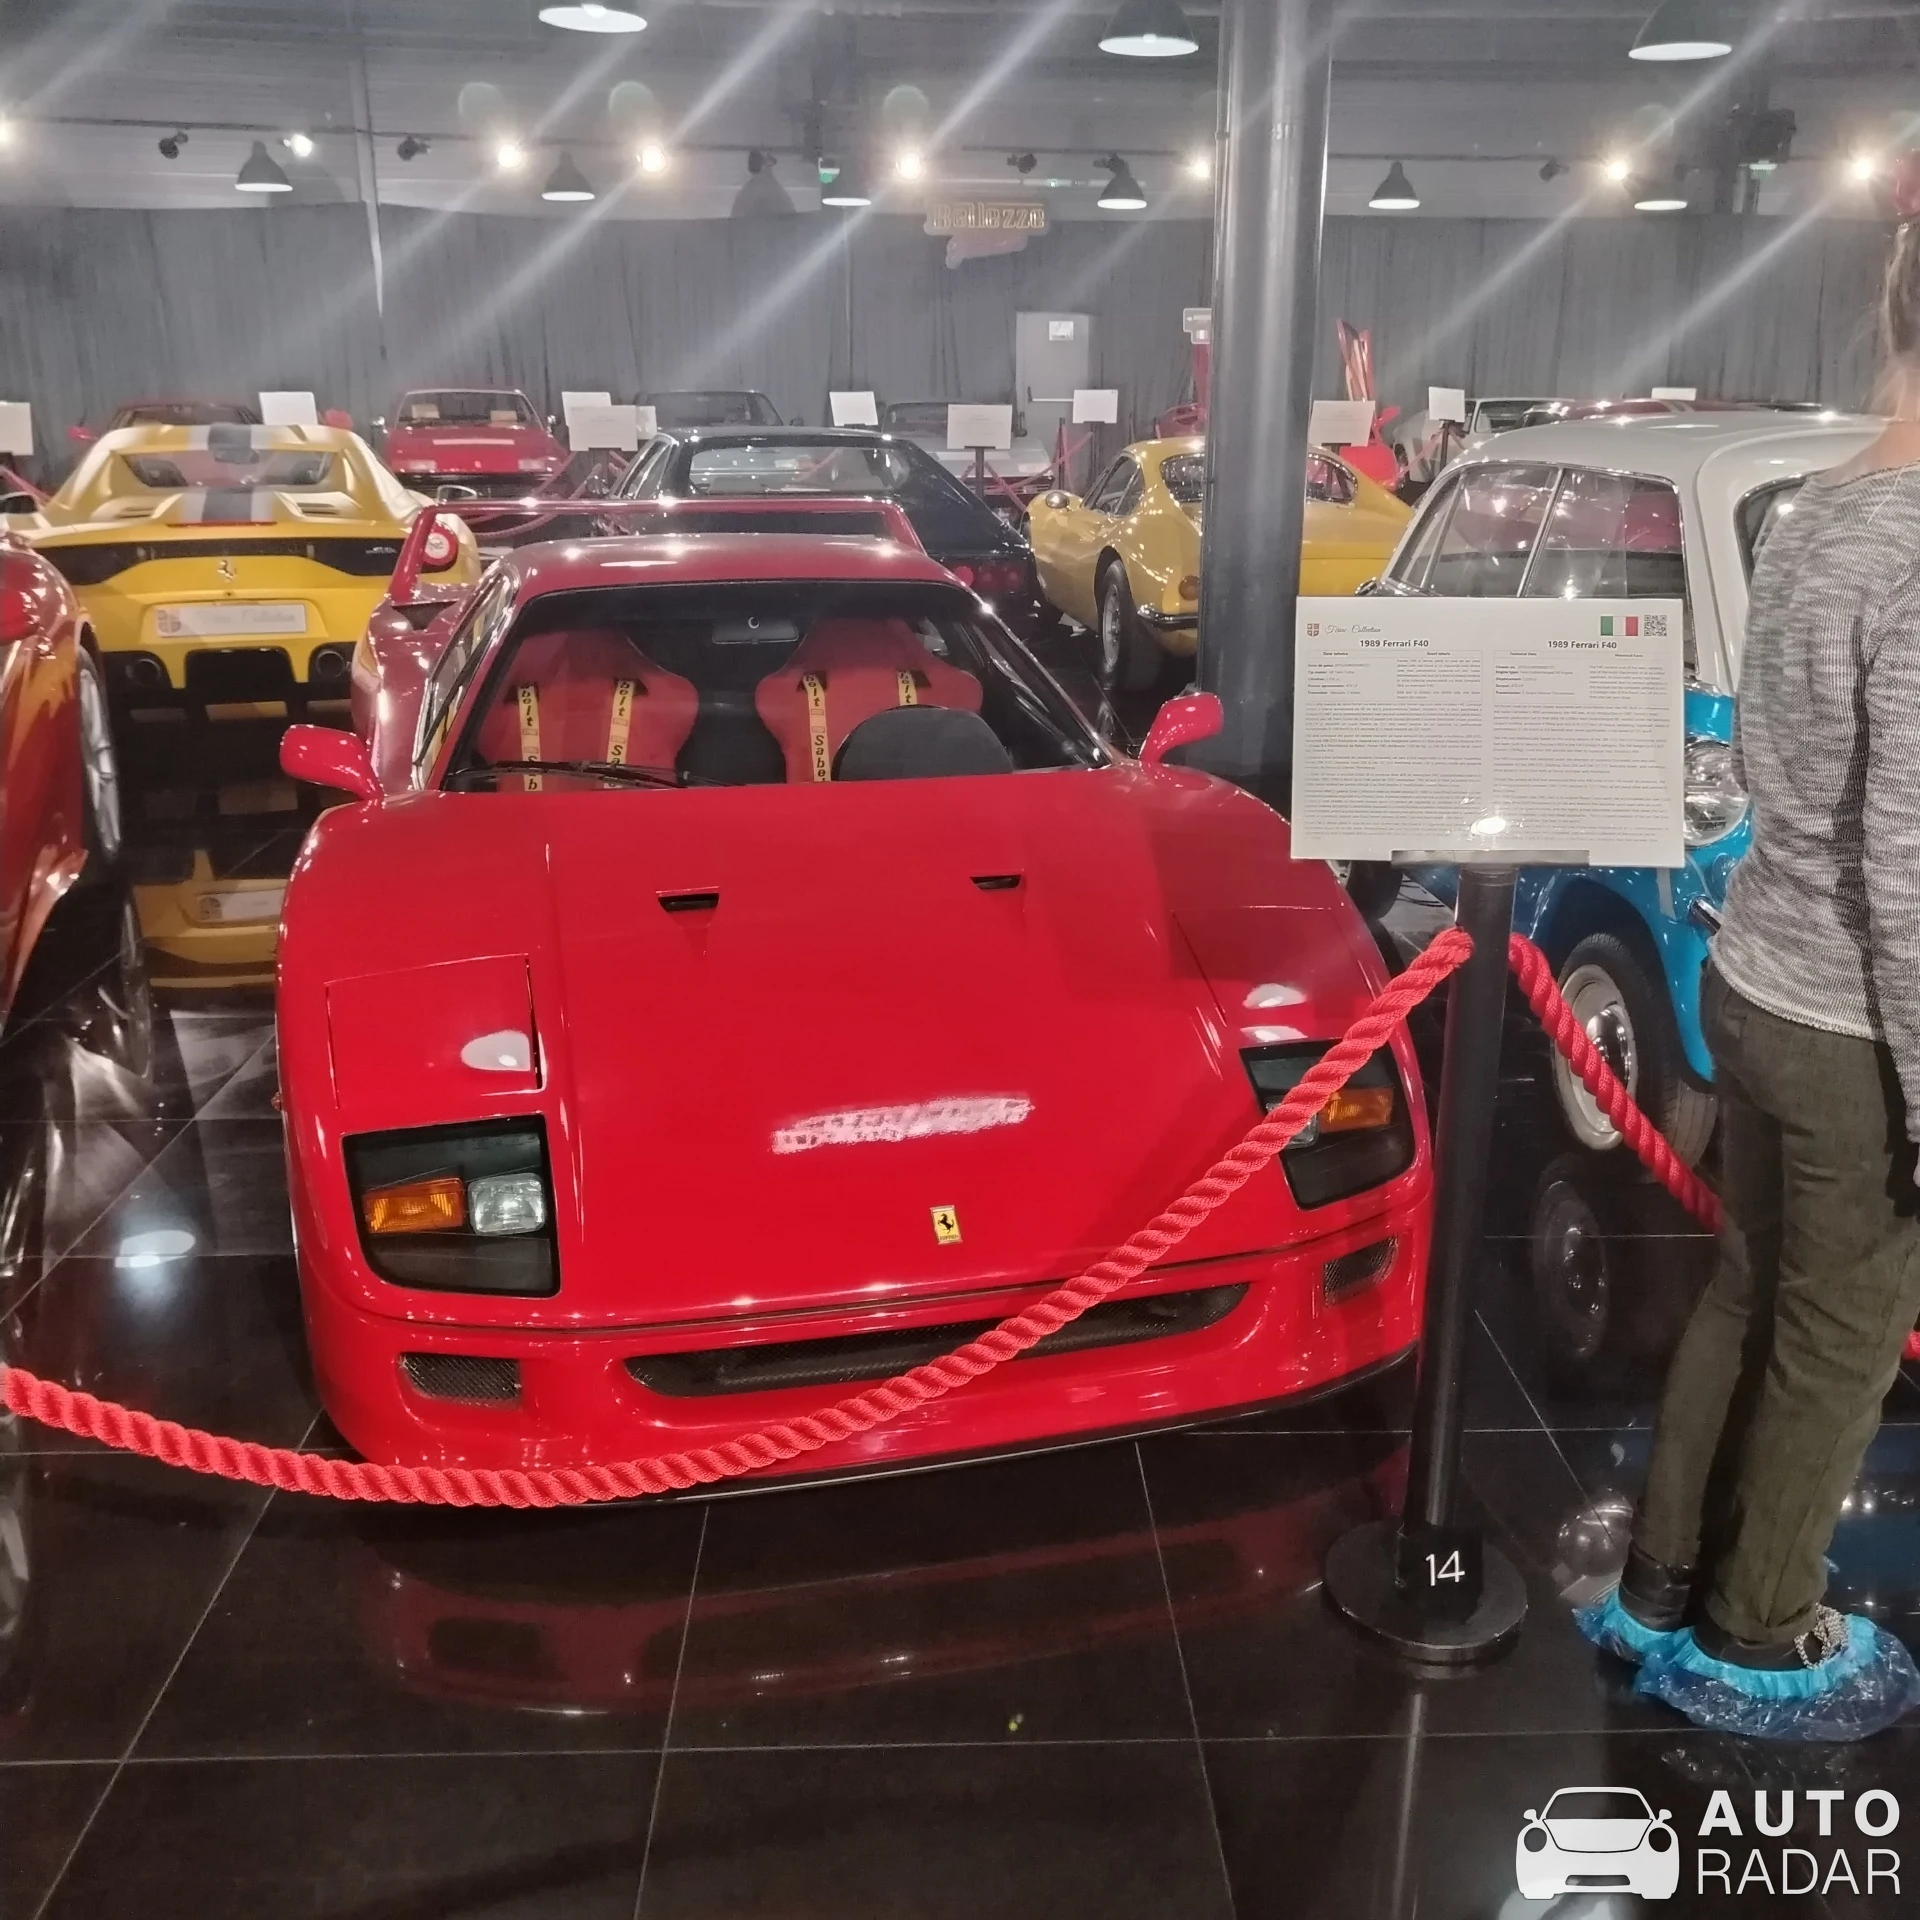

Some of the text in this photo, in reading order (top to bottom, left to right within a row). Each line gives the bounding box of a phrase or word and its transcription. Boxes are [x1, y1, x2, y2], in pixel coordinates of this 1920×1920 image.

[1359, 639, 1429, 648] 1989 Ferrari F40
[1547, 640, 1617, 649] 1989 Ferrari F40
[1425, 1550, 1466, 1587] 14
